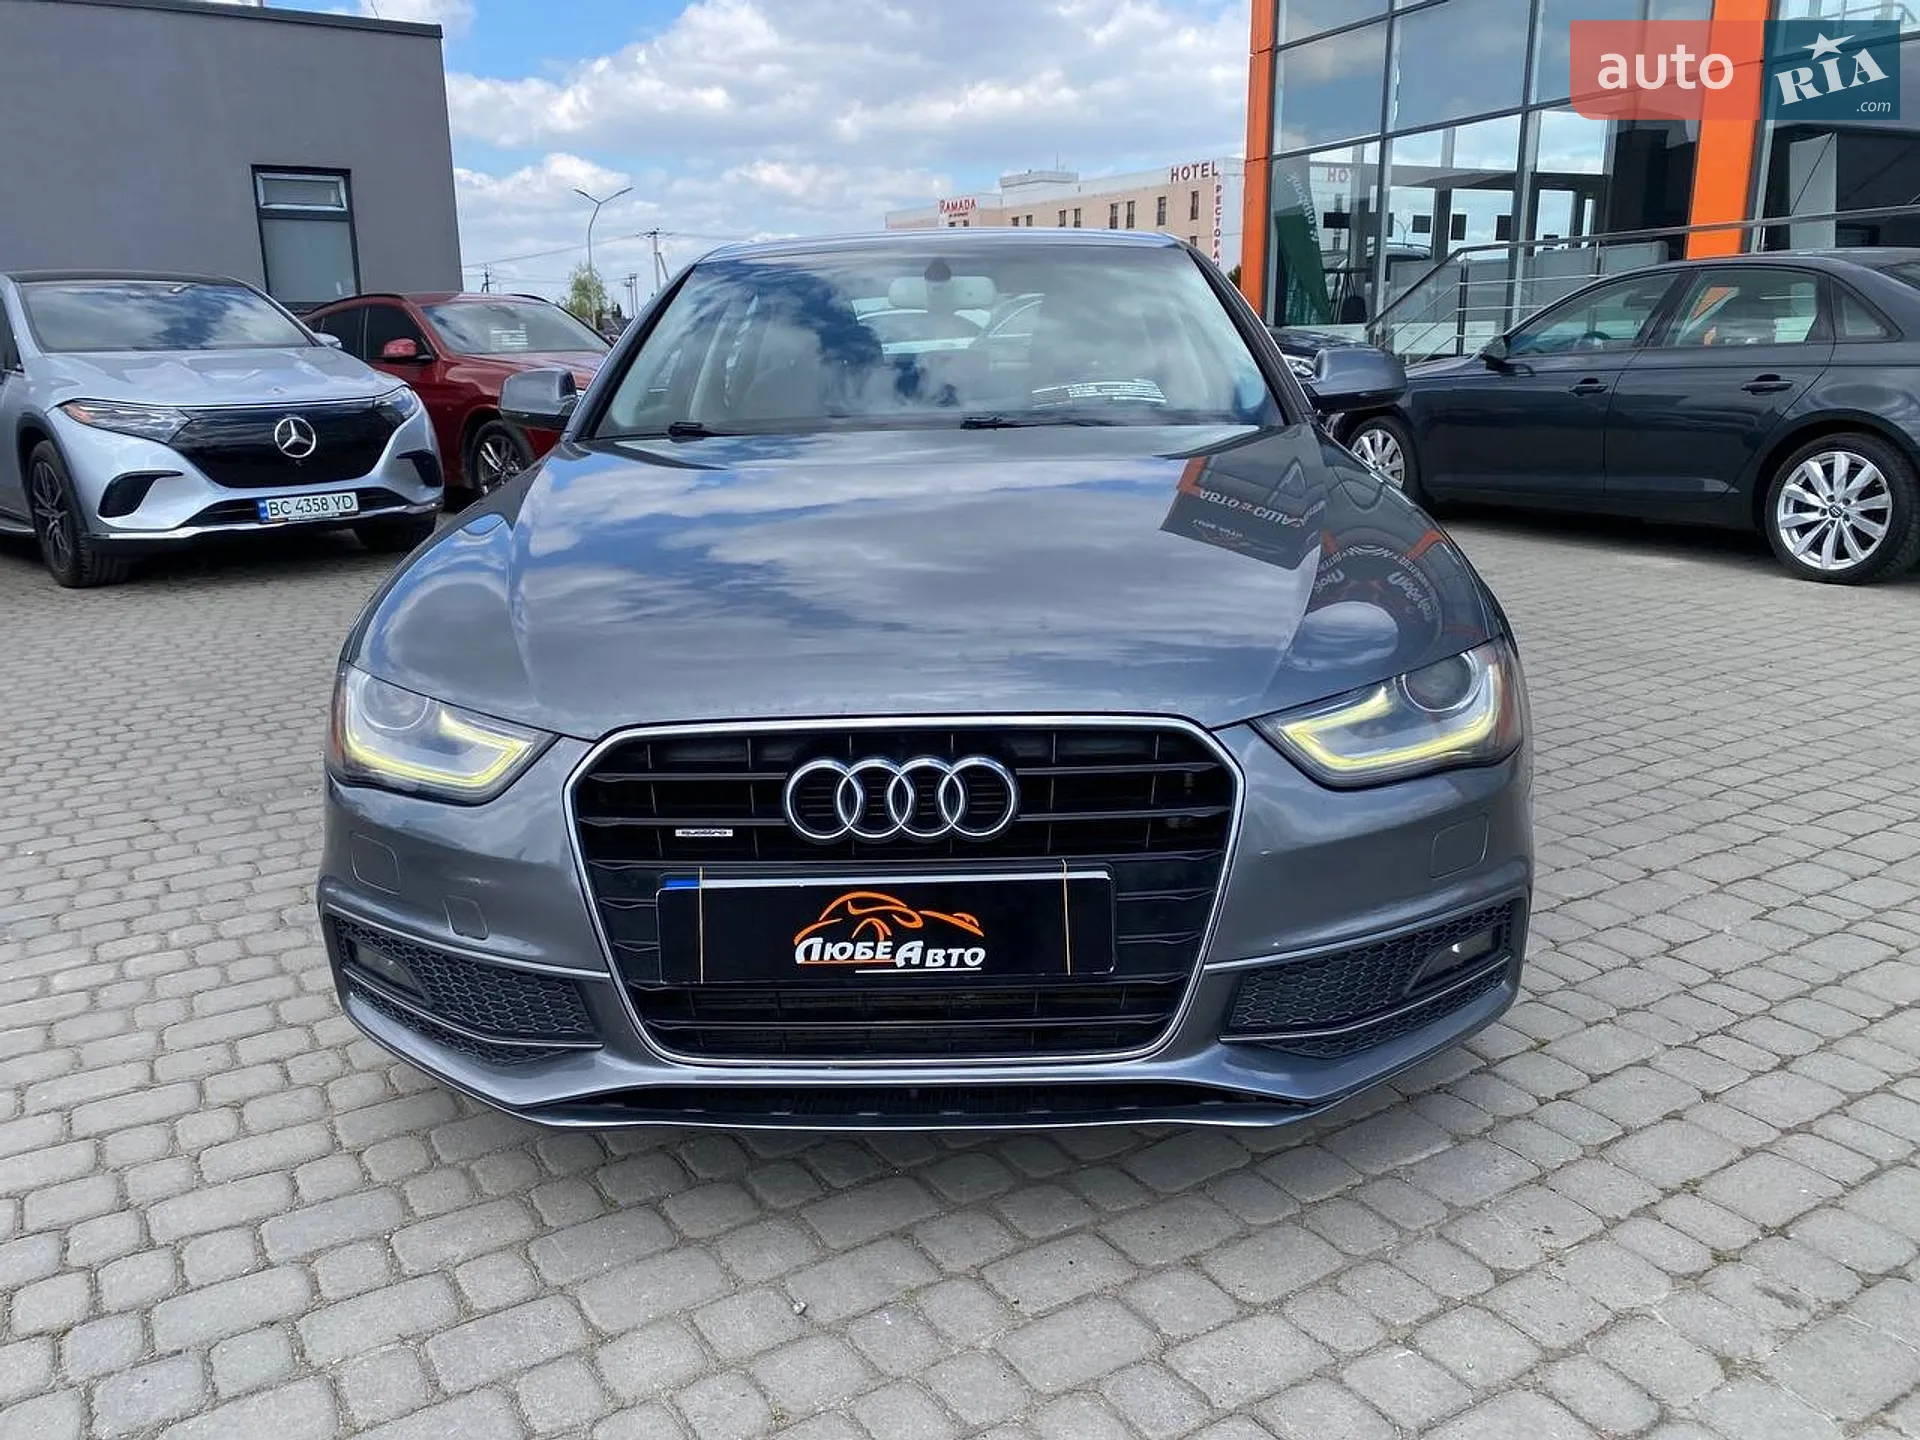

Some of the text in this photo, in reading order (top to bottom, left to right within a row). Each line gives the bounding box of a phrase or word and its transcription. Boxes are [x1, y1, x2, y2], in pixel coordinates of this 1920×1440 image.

[1170, 160, 1219, 183] HOTEL
[939, 197, 976, 214] RAMADA
[268, 501, 292, 517] BC
[295, 497, 330, 514] 4358
[332, 494, 354, 511] YD
